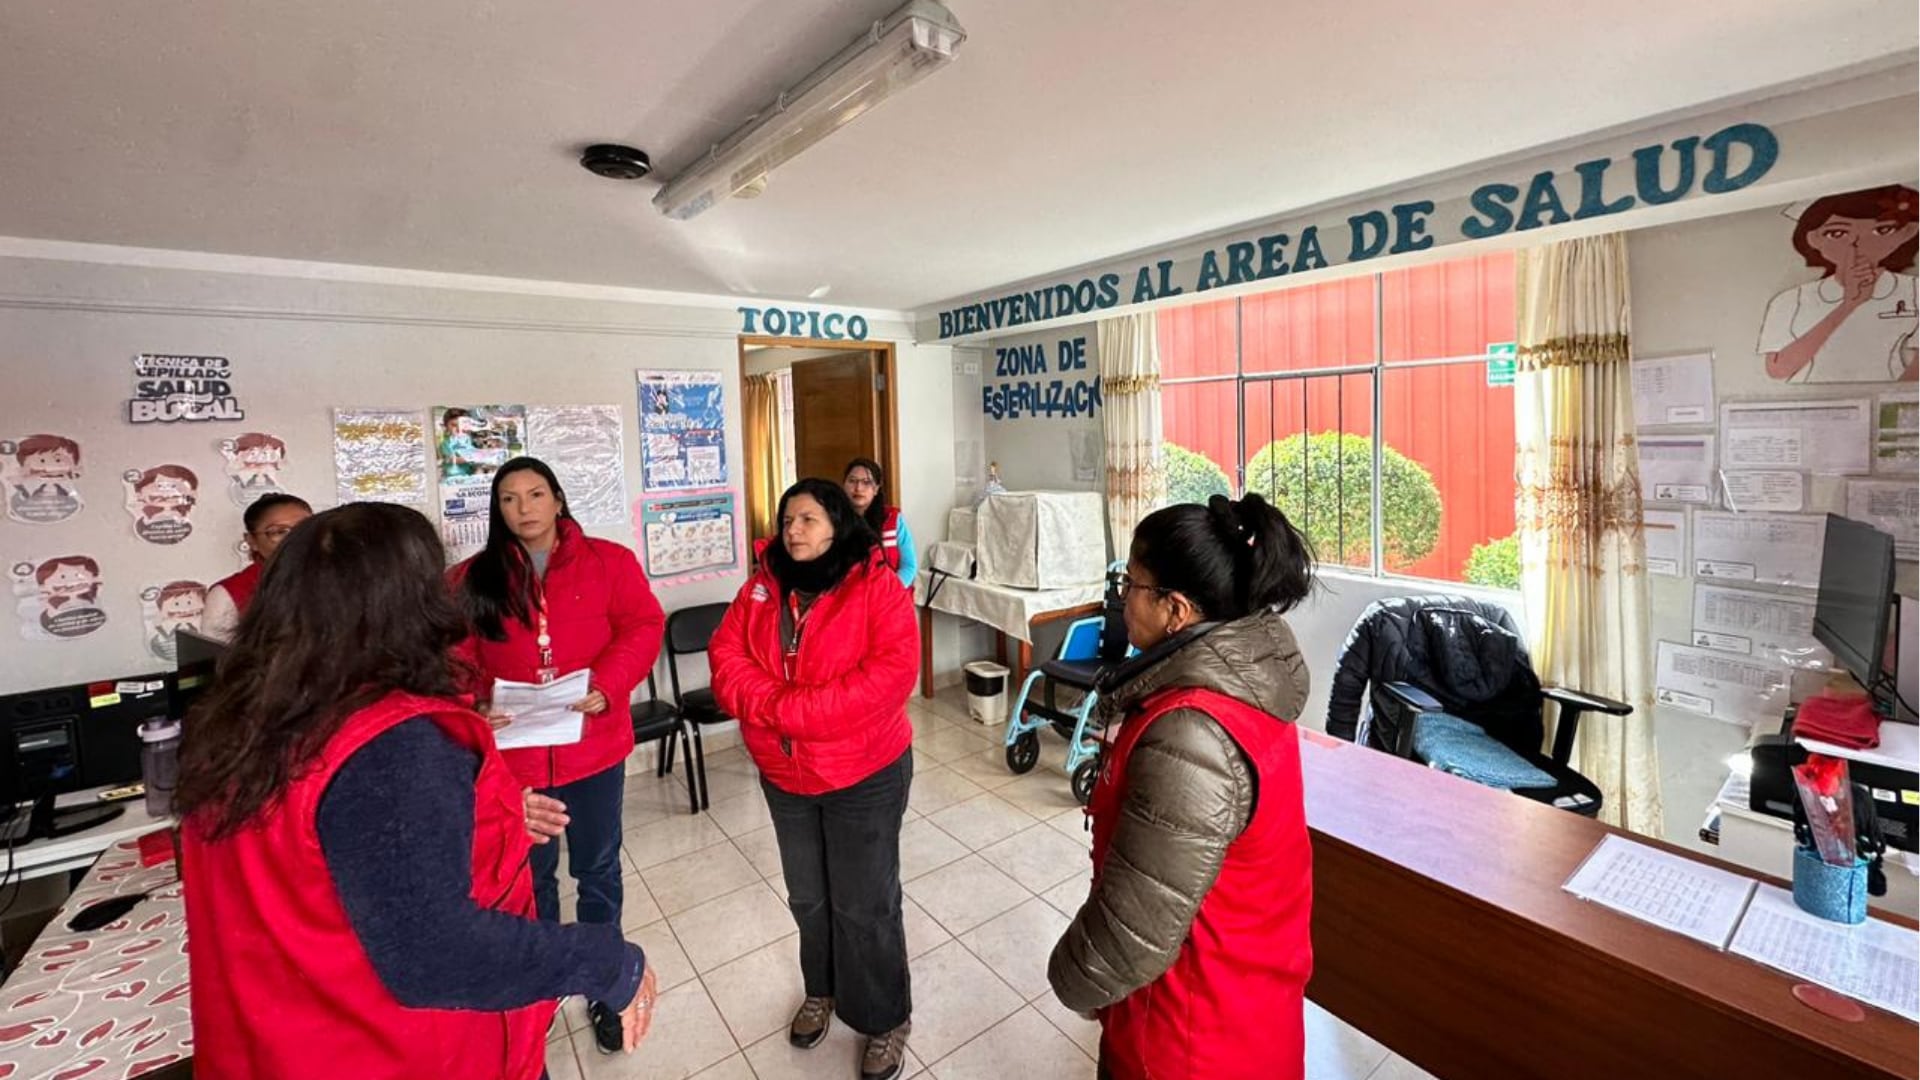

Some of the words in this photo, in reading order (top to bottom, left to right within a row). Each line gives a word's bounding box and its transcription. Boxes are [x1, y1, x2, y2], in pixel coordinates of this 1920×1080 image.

[939, 274, 1120, 339] BIENVENIDOS
[1132, 260, 1182, 303] AL
[1196, 226, 1328, 292] AREA
[1347, 200, 1435, 262] DE
[1461, 123, 1780, 240] SALUD
[737, 307, 868, 341] TOPICO
[996, 344, 1047, 376] ZONA
[1058, 337, 1086, 372] DE
[137, 381, 232, 398] SALUD
[130, 397, 244, 423] BUCAL
